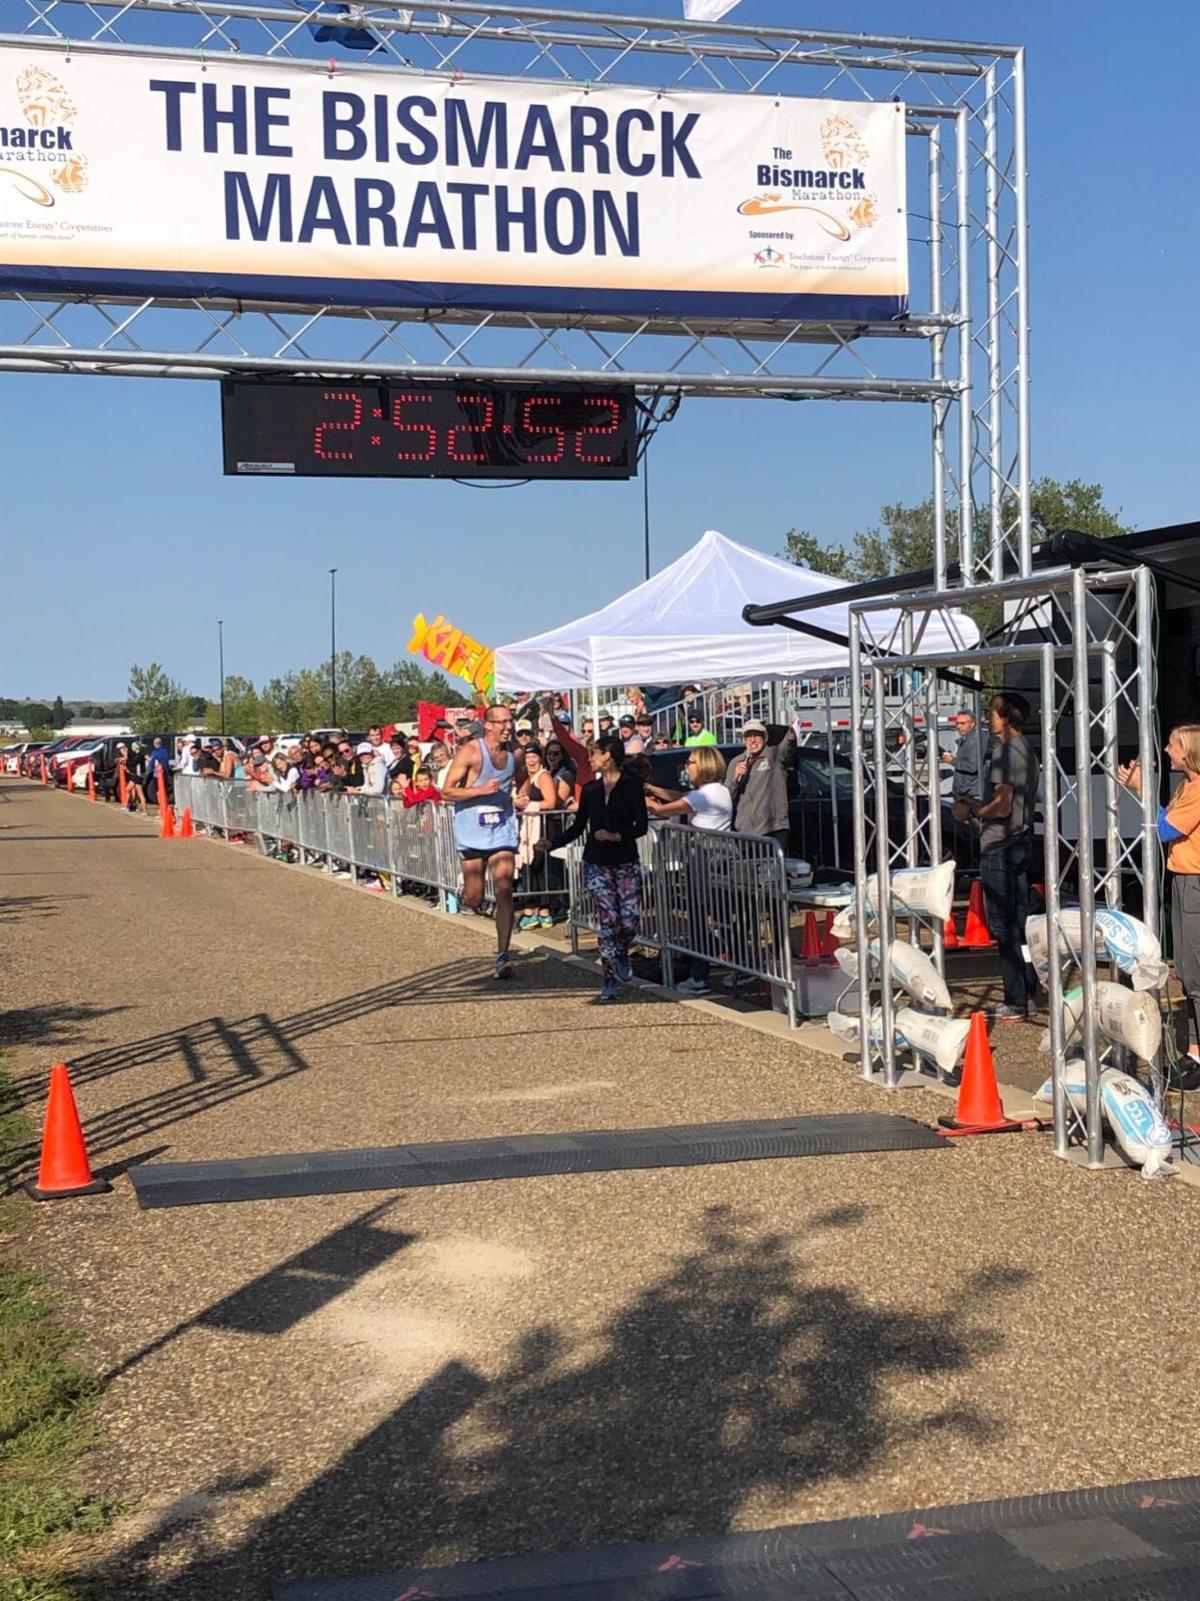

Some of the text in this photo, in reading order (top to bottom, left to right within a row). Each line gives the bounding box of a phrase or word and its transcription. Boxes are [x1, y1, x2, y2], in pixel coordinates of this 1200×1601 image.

[149, 79, 703, 179] THE BISMARCK
[773, 147, 793, 160] The
[757, 164, 866, 189] Bismarck
[792, 189, 861, 201] Marathon
[223, 170, 641, 258] MARATHON
